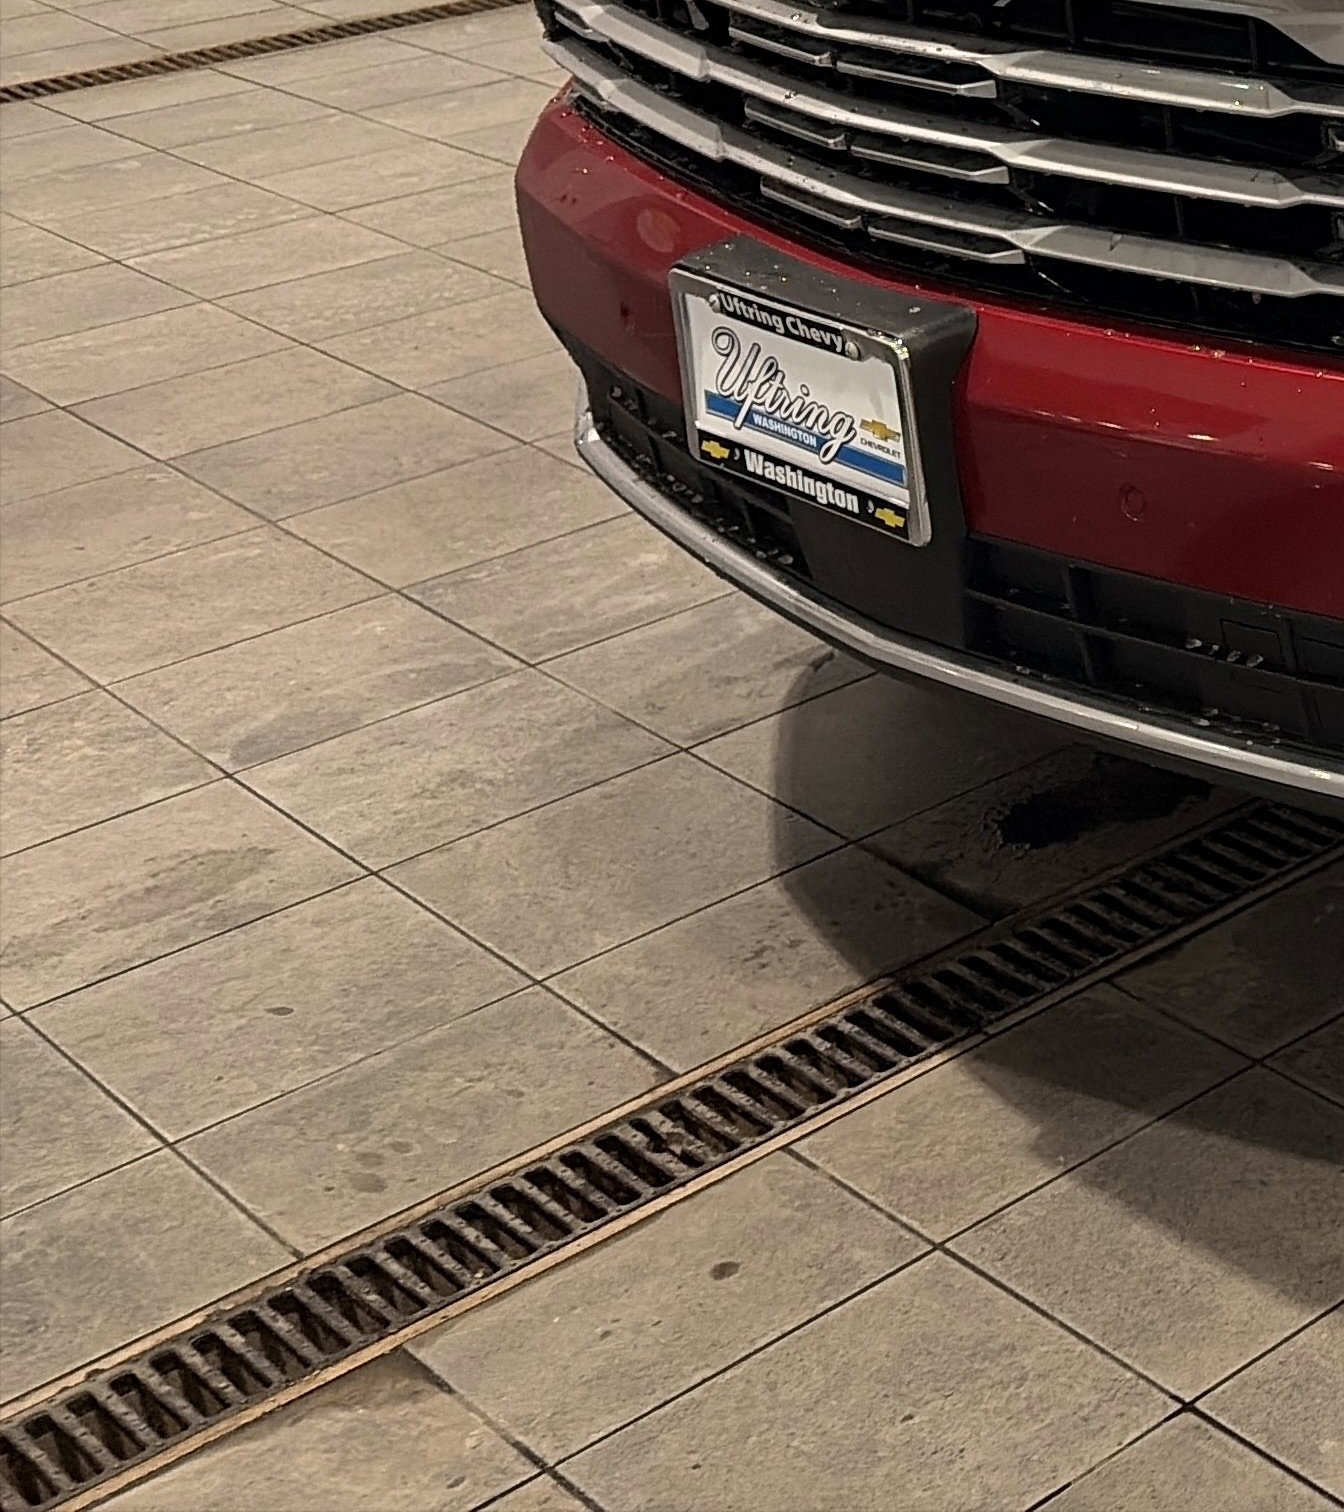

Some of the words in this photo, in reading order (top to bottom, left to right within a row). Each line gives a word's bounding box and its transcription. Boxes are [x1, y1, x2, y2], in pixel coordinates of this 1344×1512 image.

[720, 292, 785, 333] Uftring
[787, 317, 843, 354] Chevy
[711, 326, 857, 464] Uftring
[752, 412, 817, 449] WASHINGTON
[860, 438, 901, 459] CHEVROLET
[743, 448, 860, 515] Washington
